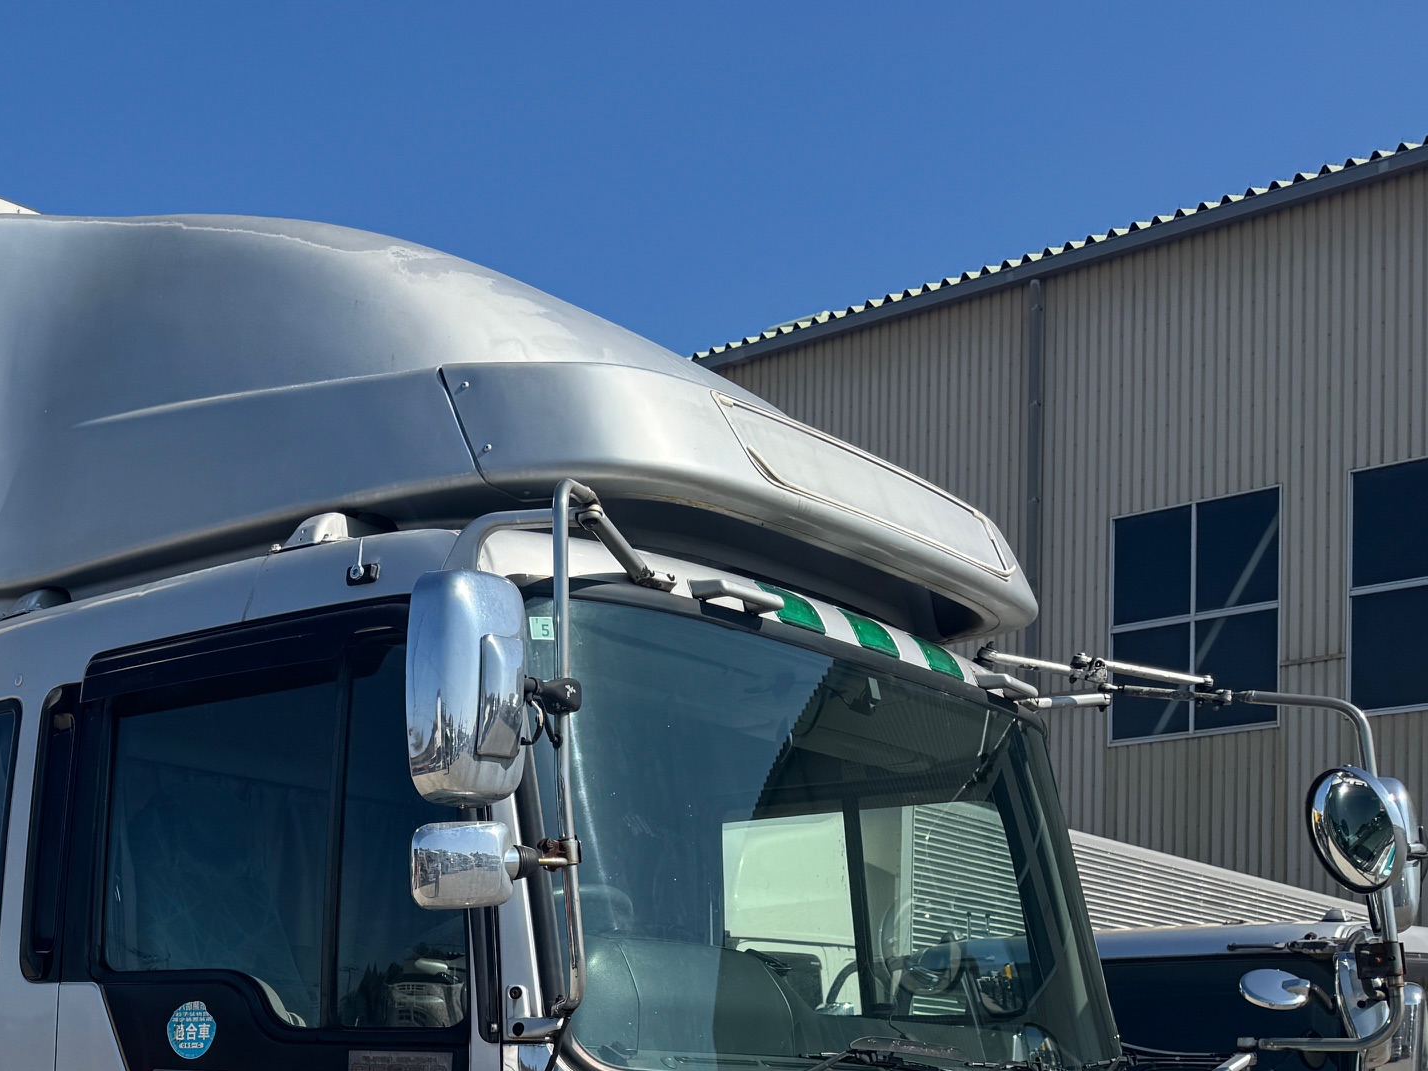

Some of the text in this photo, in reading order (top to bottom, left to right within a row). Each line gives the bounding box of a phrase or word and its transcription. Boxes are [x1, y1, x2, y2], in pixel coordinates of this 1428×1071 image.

[542, 624, 549, 636] 5
[173, 1022, 211, 1041] 適合車
